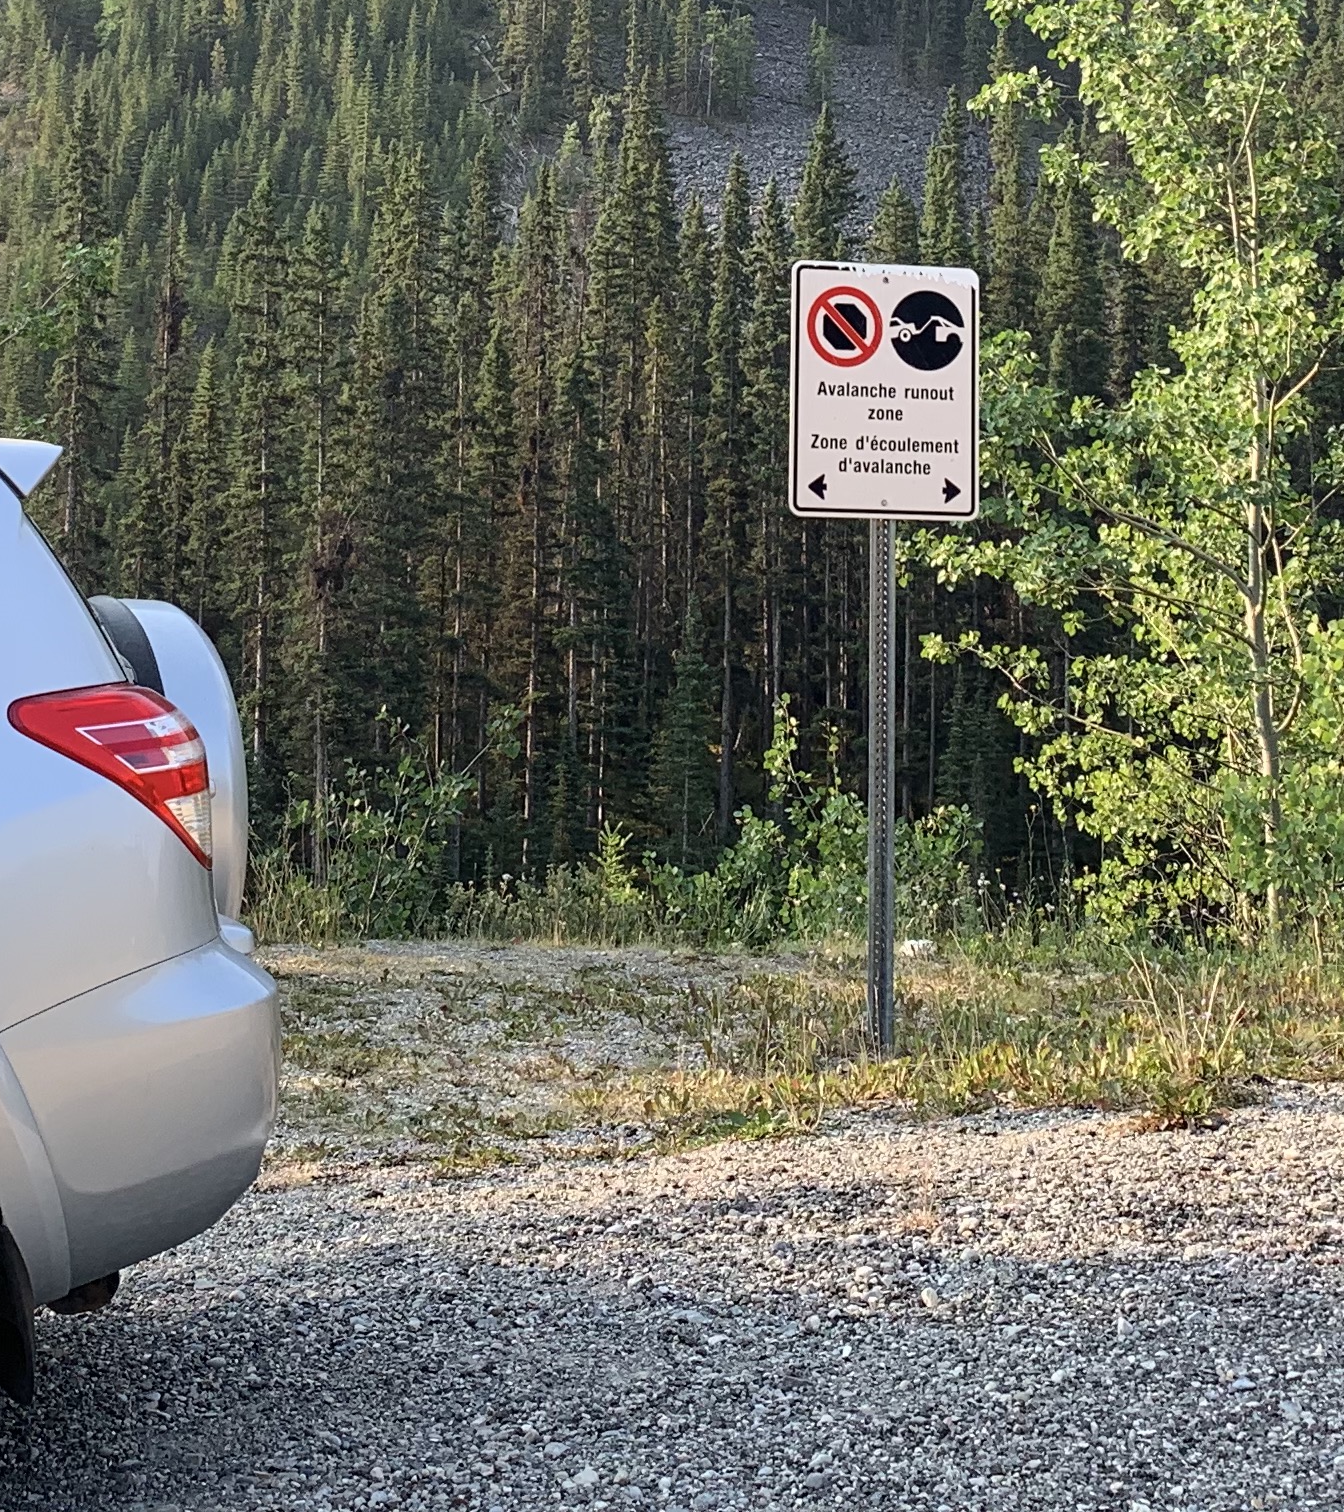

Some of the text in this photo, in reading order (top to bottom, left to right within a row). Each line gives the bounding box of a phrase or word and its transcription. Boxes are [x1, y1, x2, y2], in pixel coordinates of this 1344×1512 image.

[817, 381, 955, 401] Avalanche runout
[867, 408, 904, 421] zone
[810, 433, 960, 455] Zone d'écoulement
[838, 457, 932, 476] d'avalanche
